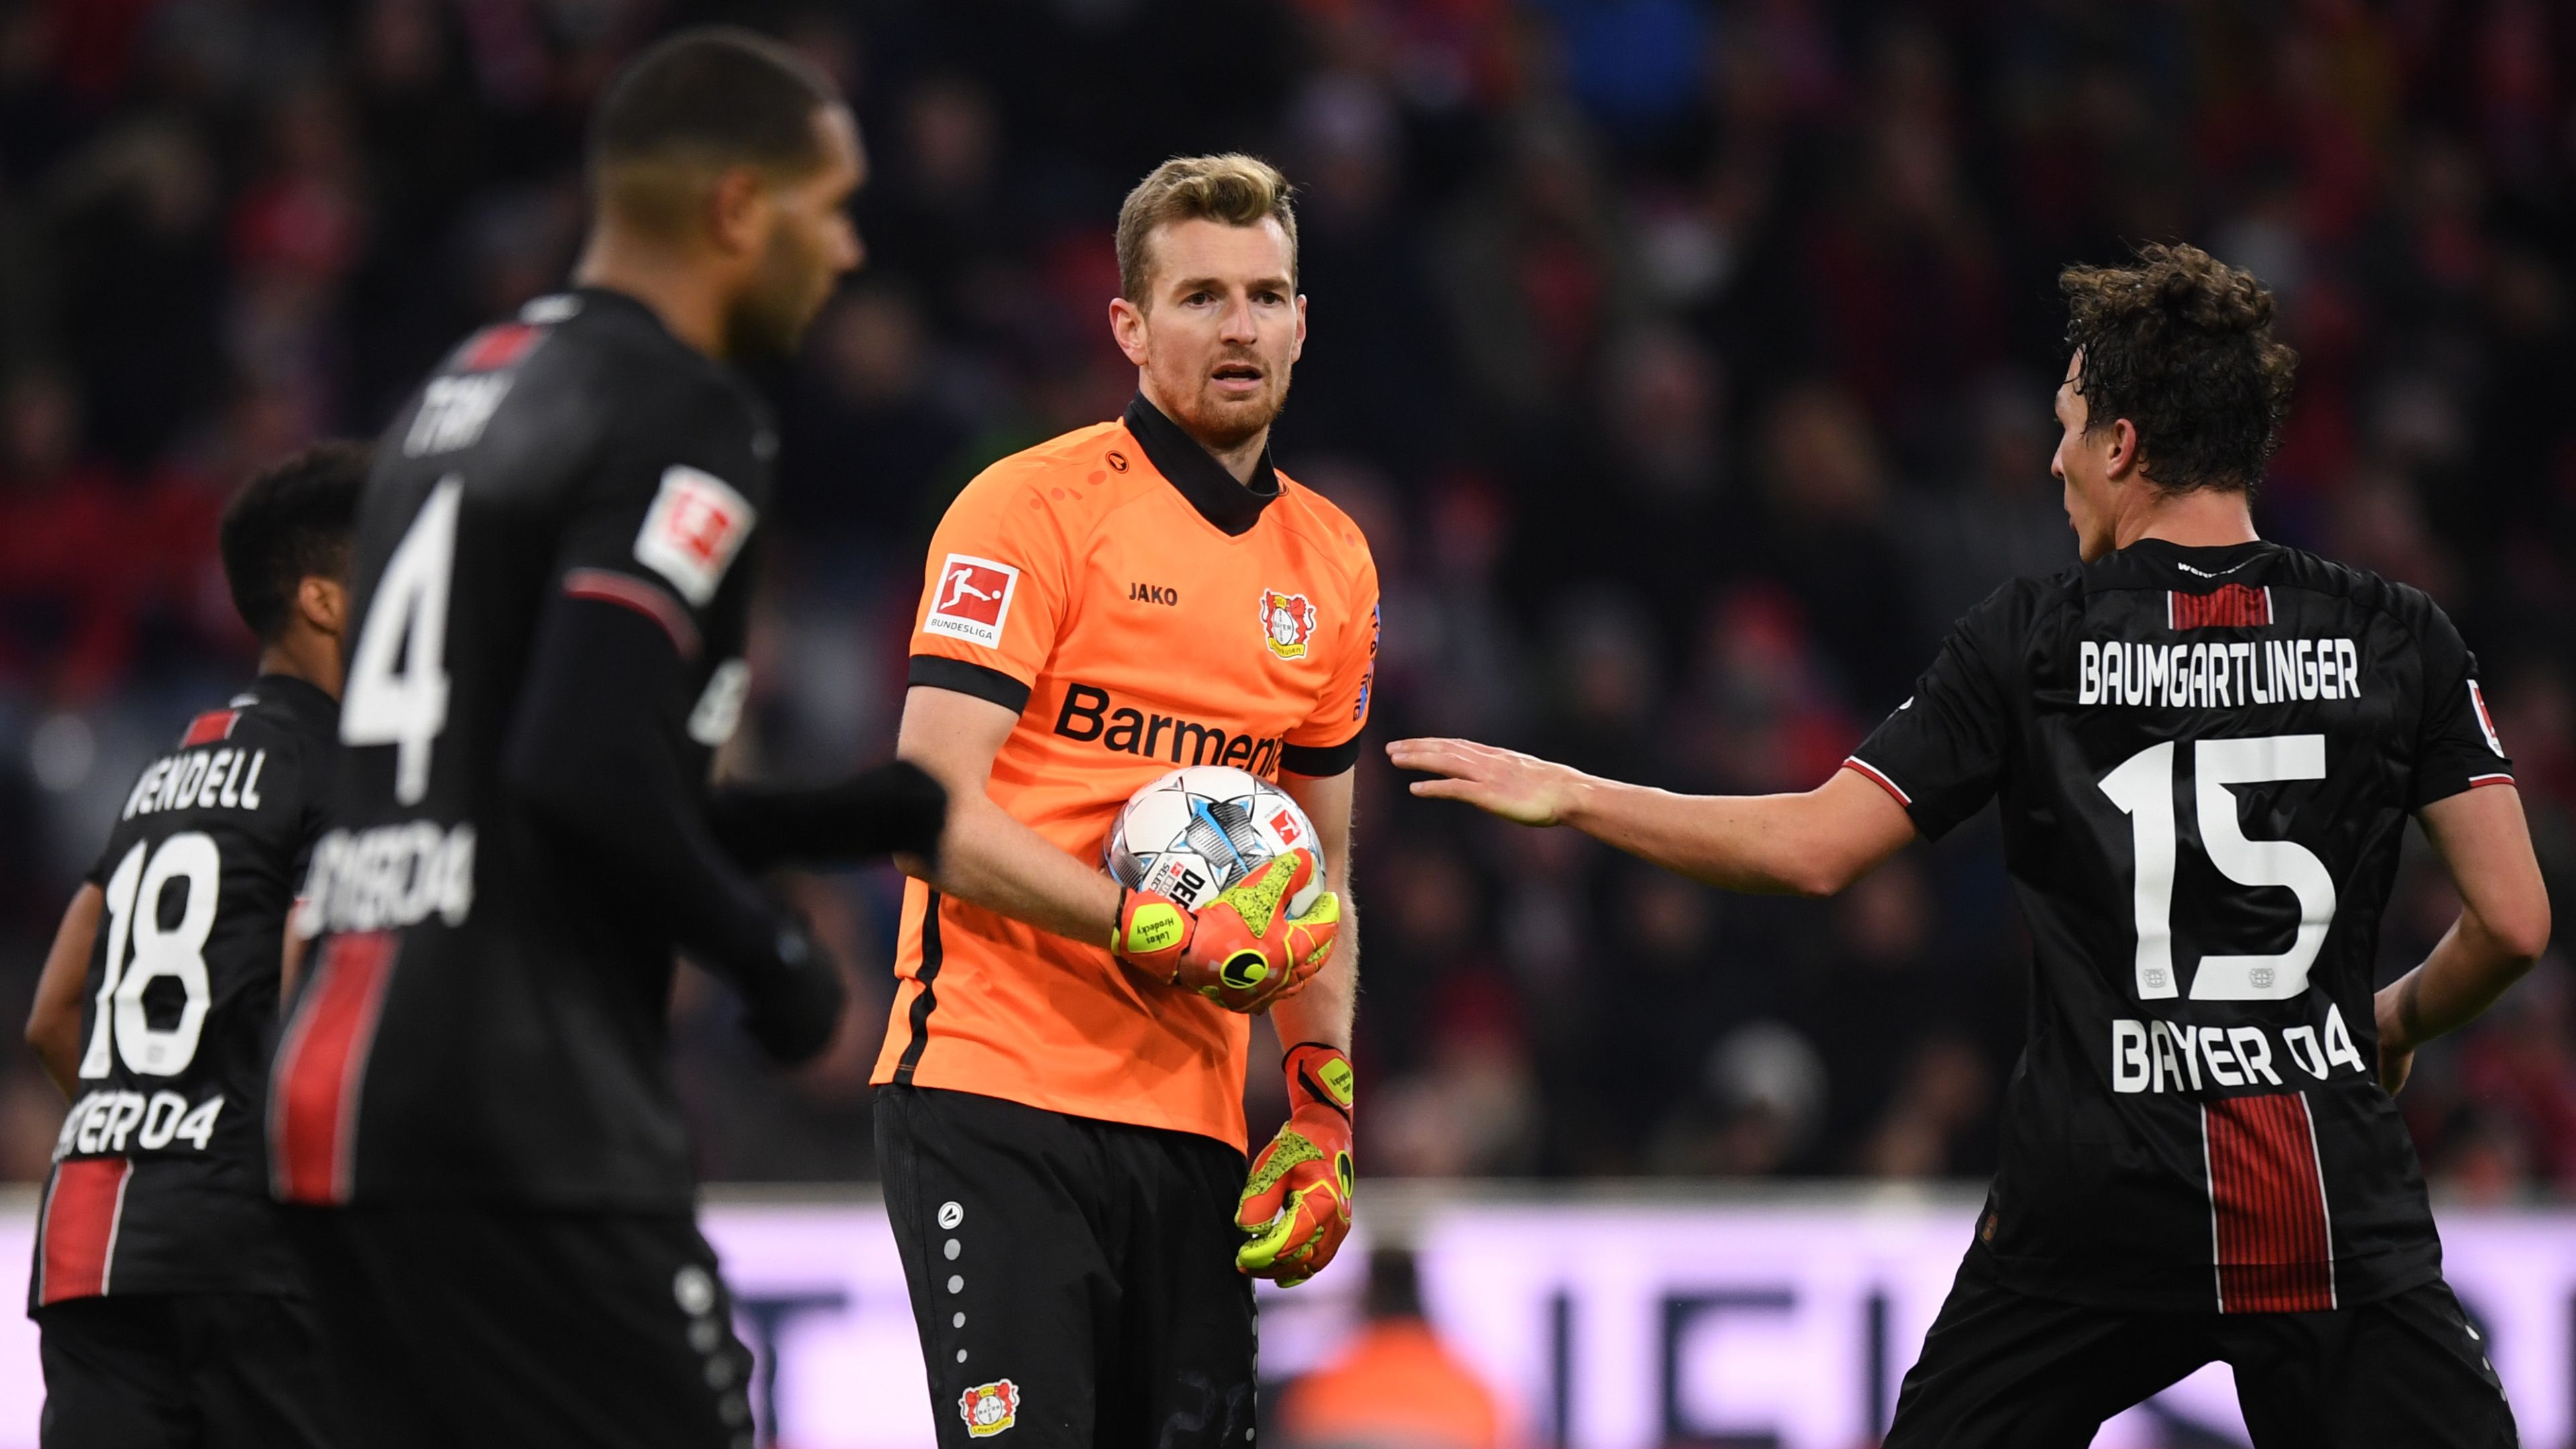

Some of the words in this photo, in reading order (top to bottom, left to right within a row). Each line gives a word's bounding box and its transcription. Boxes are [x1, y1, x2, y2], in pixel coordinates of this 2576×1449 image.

[1128, 582, 1178, 607] JAKO
[339, 471, 464, 805] 4
[930, 618, 993, 641] BUNDESLIGA
[2078, 638, 2361, 708] BAUMGARTLINGER
[2097, 734, 2337, 1001] 15
[78, 831, 221, 1079] 18
[1136, 916, 1175, 936] Hrodecky
[1145, 930, 1170, 945] Lukas
[2112, 1018, 2284, 1094] BAYER
[2282, 1002, 2367, 1081] 04
[138, 1089, 225, 1150] 04
